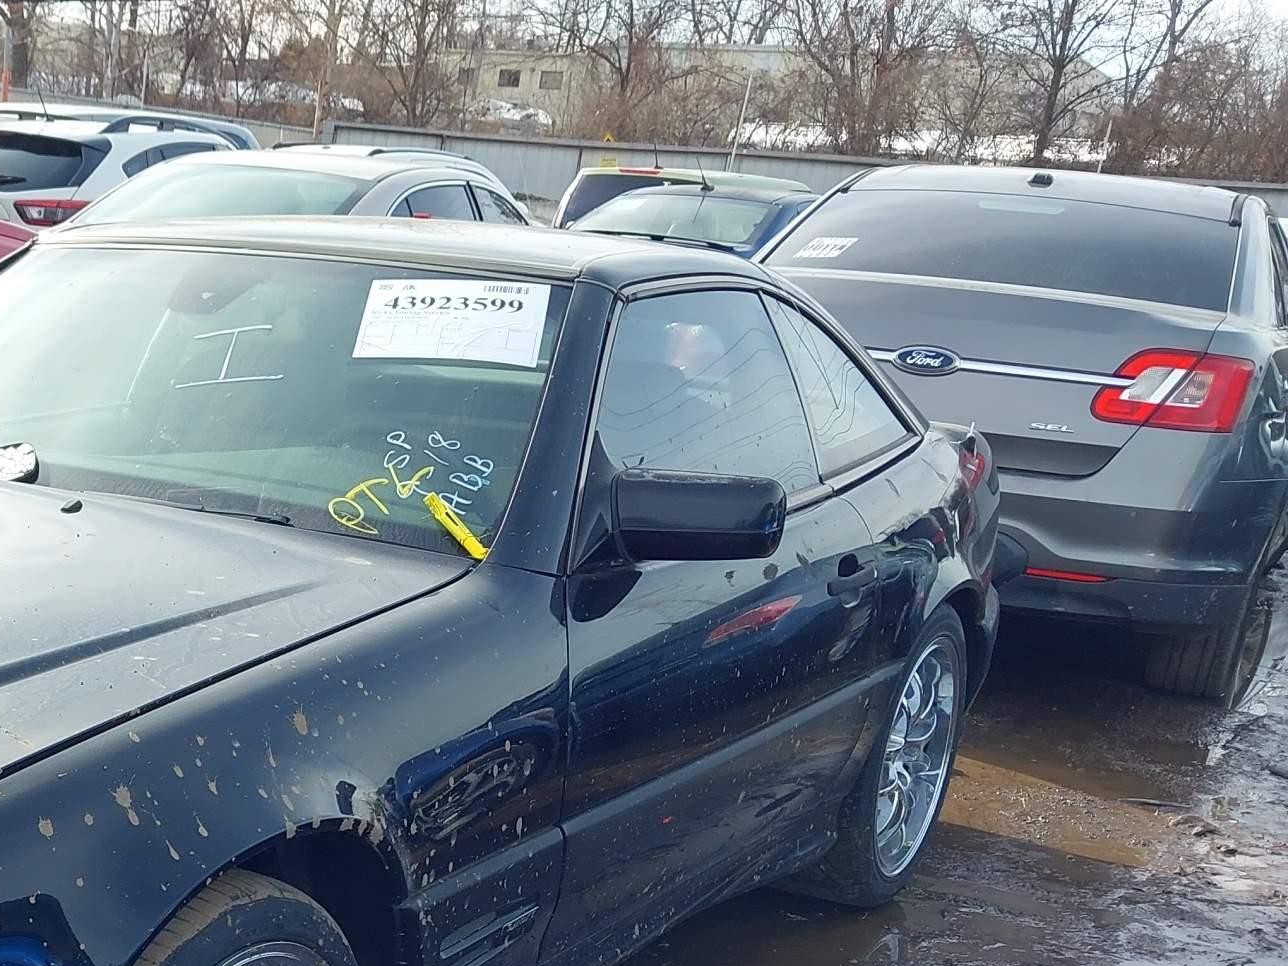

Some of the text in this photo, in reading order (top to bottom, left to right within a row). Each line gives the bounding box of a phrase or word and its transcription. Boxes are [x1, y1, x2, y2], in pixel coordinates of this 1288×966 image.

[384, 295, 524, 314] 43923599
[906, 350, 945, 367] Ford
[1029, 422, 1074, 433] SEL
